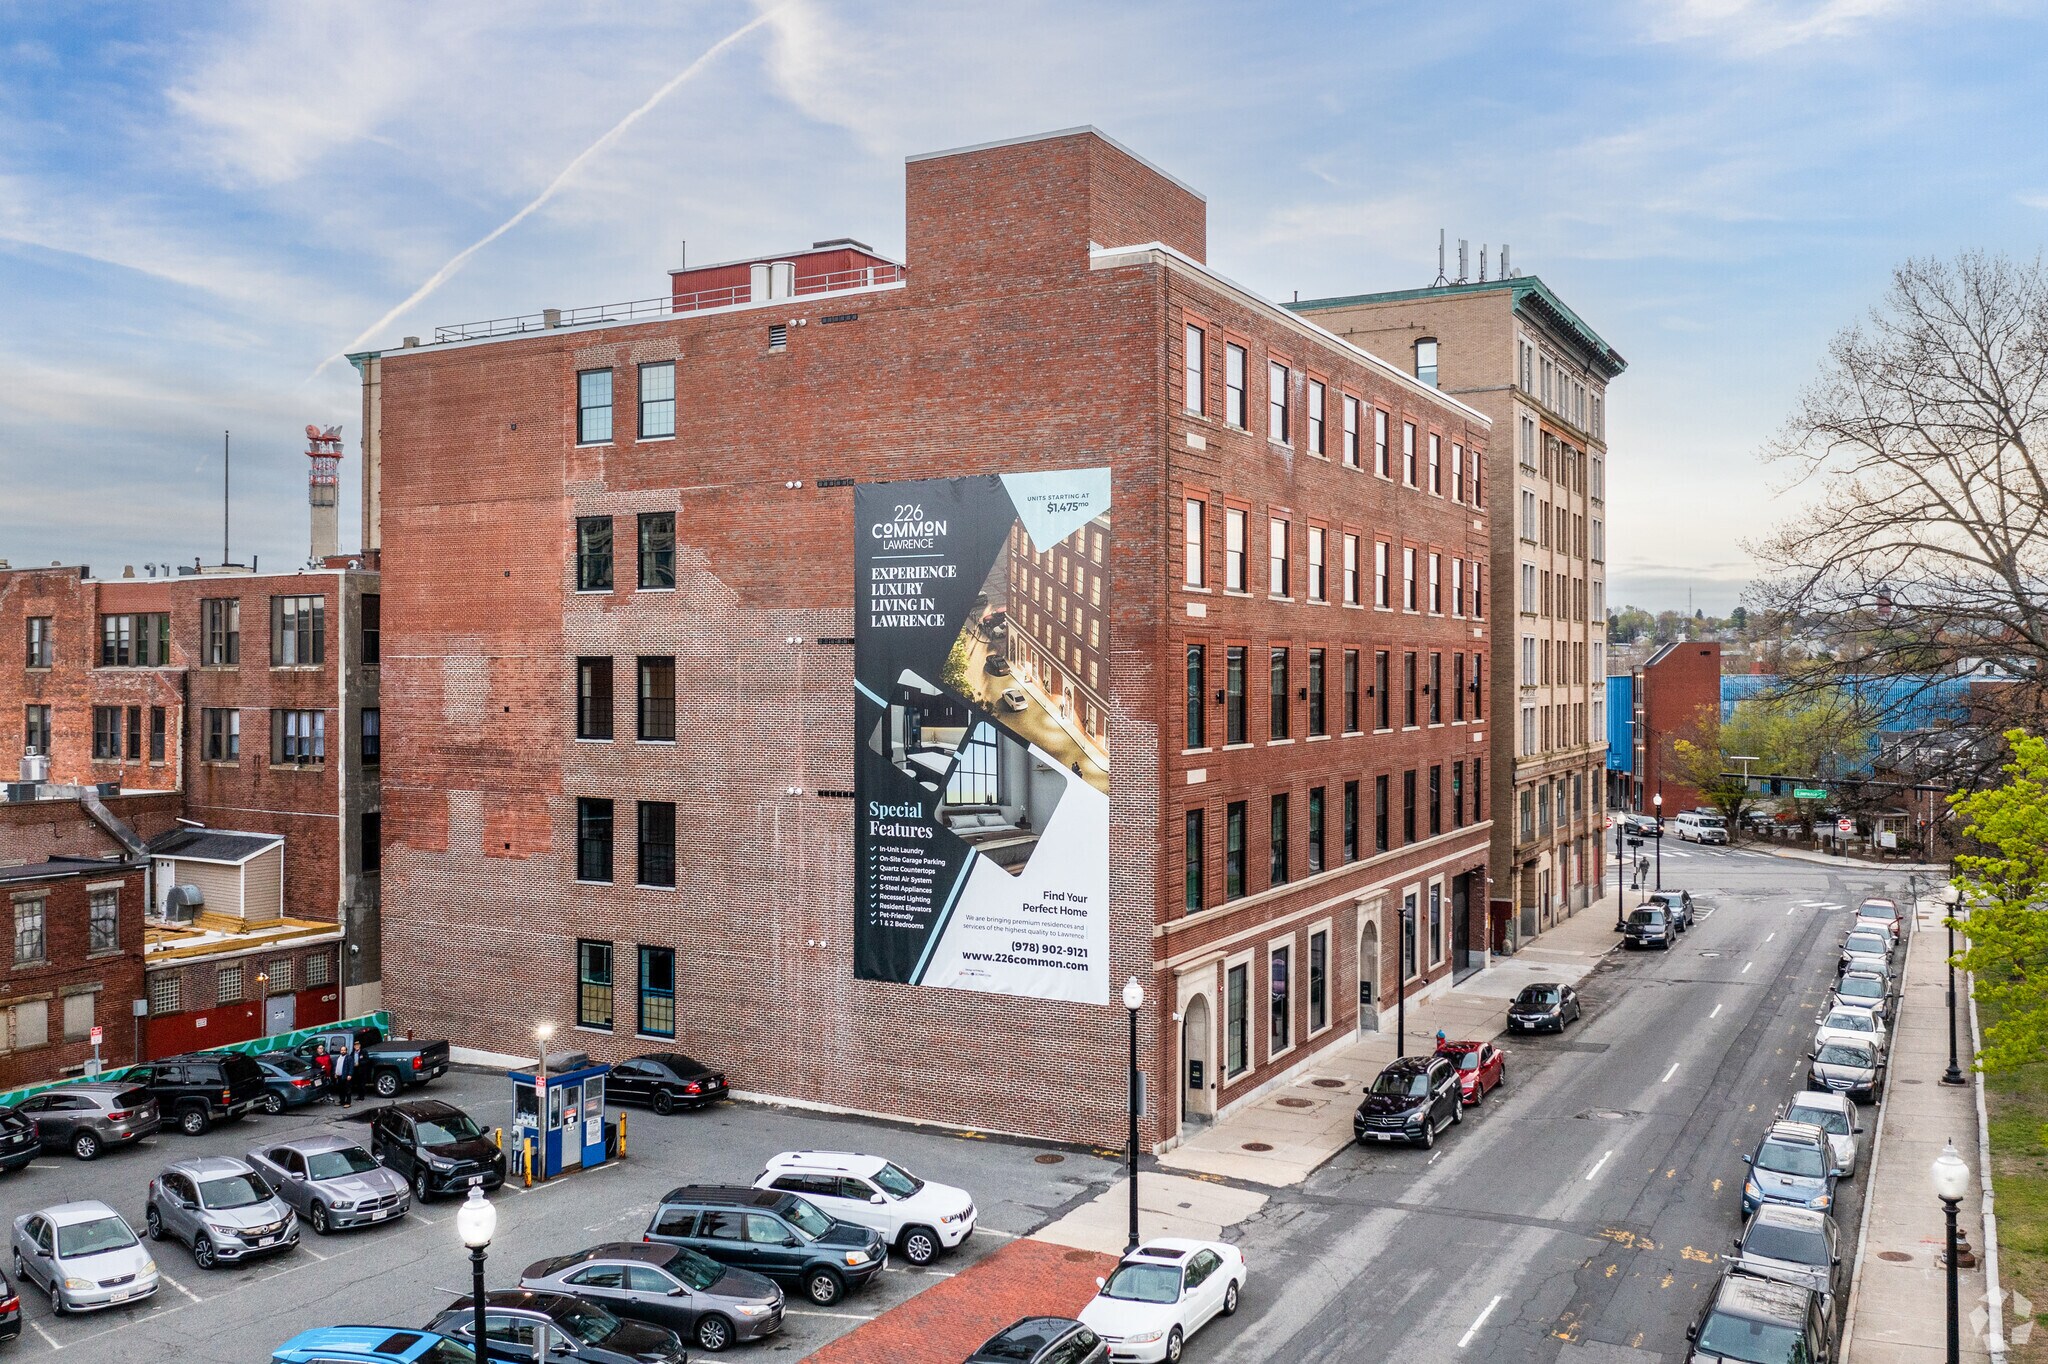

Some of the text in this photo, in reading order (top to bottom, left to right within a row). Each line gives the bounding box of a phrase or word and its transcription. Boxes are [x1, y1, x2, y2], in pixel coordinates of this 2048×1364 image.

[1048, 493, 1079, 501] STARTING
[894, 504, 924, 521] 226
[883, 538, 934, 550] LAWRENCE
[871, 565, 957, 580] EXPERIENCE
[871, 582, 924, 596] LUXURY
[871, 598, 935, 612] LIVING IN
[871, 614, 945, 627] LAWRENCE
[869, 801, 922, 820] Special
[869, 821, 933, 839] Features
[900, 846, 924, 855] Laundry
[879, 855, 946, 867] On-Site Garage Parking
[900, 866, 935, 875] Countertops
[879, 874, 900, 882] Central
[911, 876, 932, 884] System
[900, 885, 932, 894] Appliances
[879, 893, 931, 904] Recessed Lighting
[1043, 891, 1088, 903] Find Your
[879, 903, 932, 913] Resident Elevators
[1022, 903, 1088, 917] Perfect Home
[879, 911, 914, 921] Pet-Friendly
[895, 921, 924, 930] Bedrooms
[986, 916, 1012, 925] bringing
[1012, 918, 1041, 927] premium
[1041, 921, 1073, 930] residences
[963, 923, 986, 931] services
[1005, 926, 1027, 935] highest
[1027, 928, 1049, 937] quality
[1057, 931, 1085, 940] Lawrence
[1011, 941, 1088, 958] (978) 902-9121
[962, 951, 1089, 971] www.226common.com
